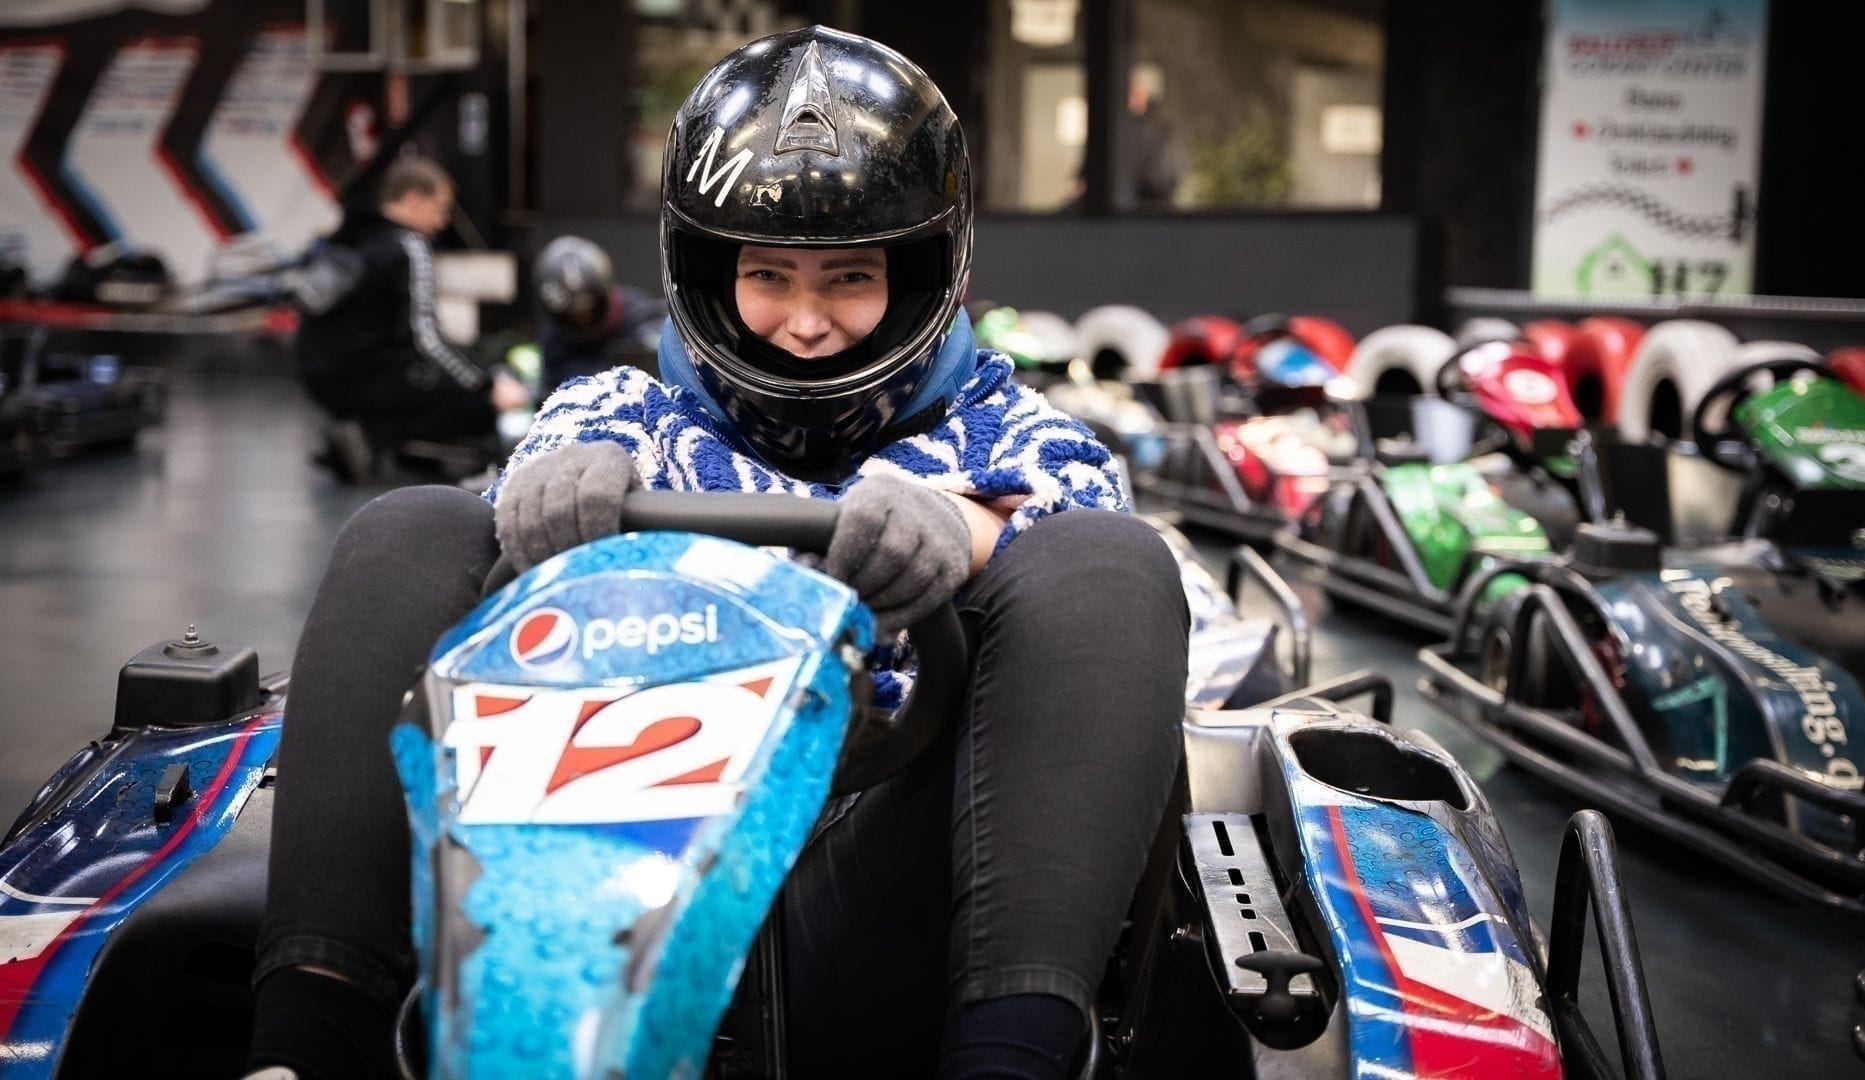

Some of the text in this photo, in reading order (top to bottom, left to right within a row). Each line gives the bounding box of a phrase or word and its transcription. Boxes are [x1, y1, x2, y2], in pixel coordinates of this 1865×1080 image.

[686, 125, 755, 208] M
[583, 604, 718, 660] pepsi
[442, 678, 778, 825] 12
